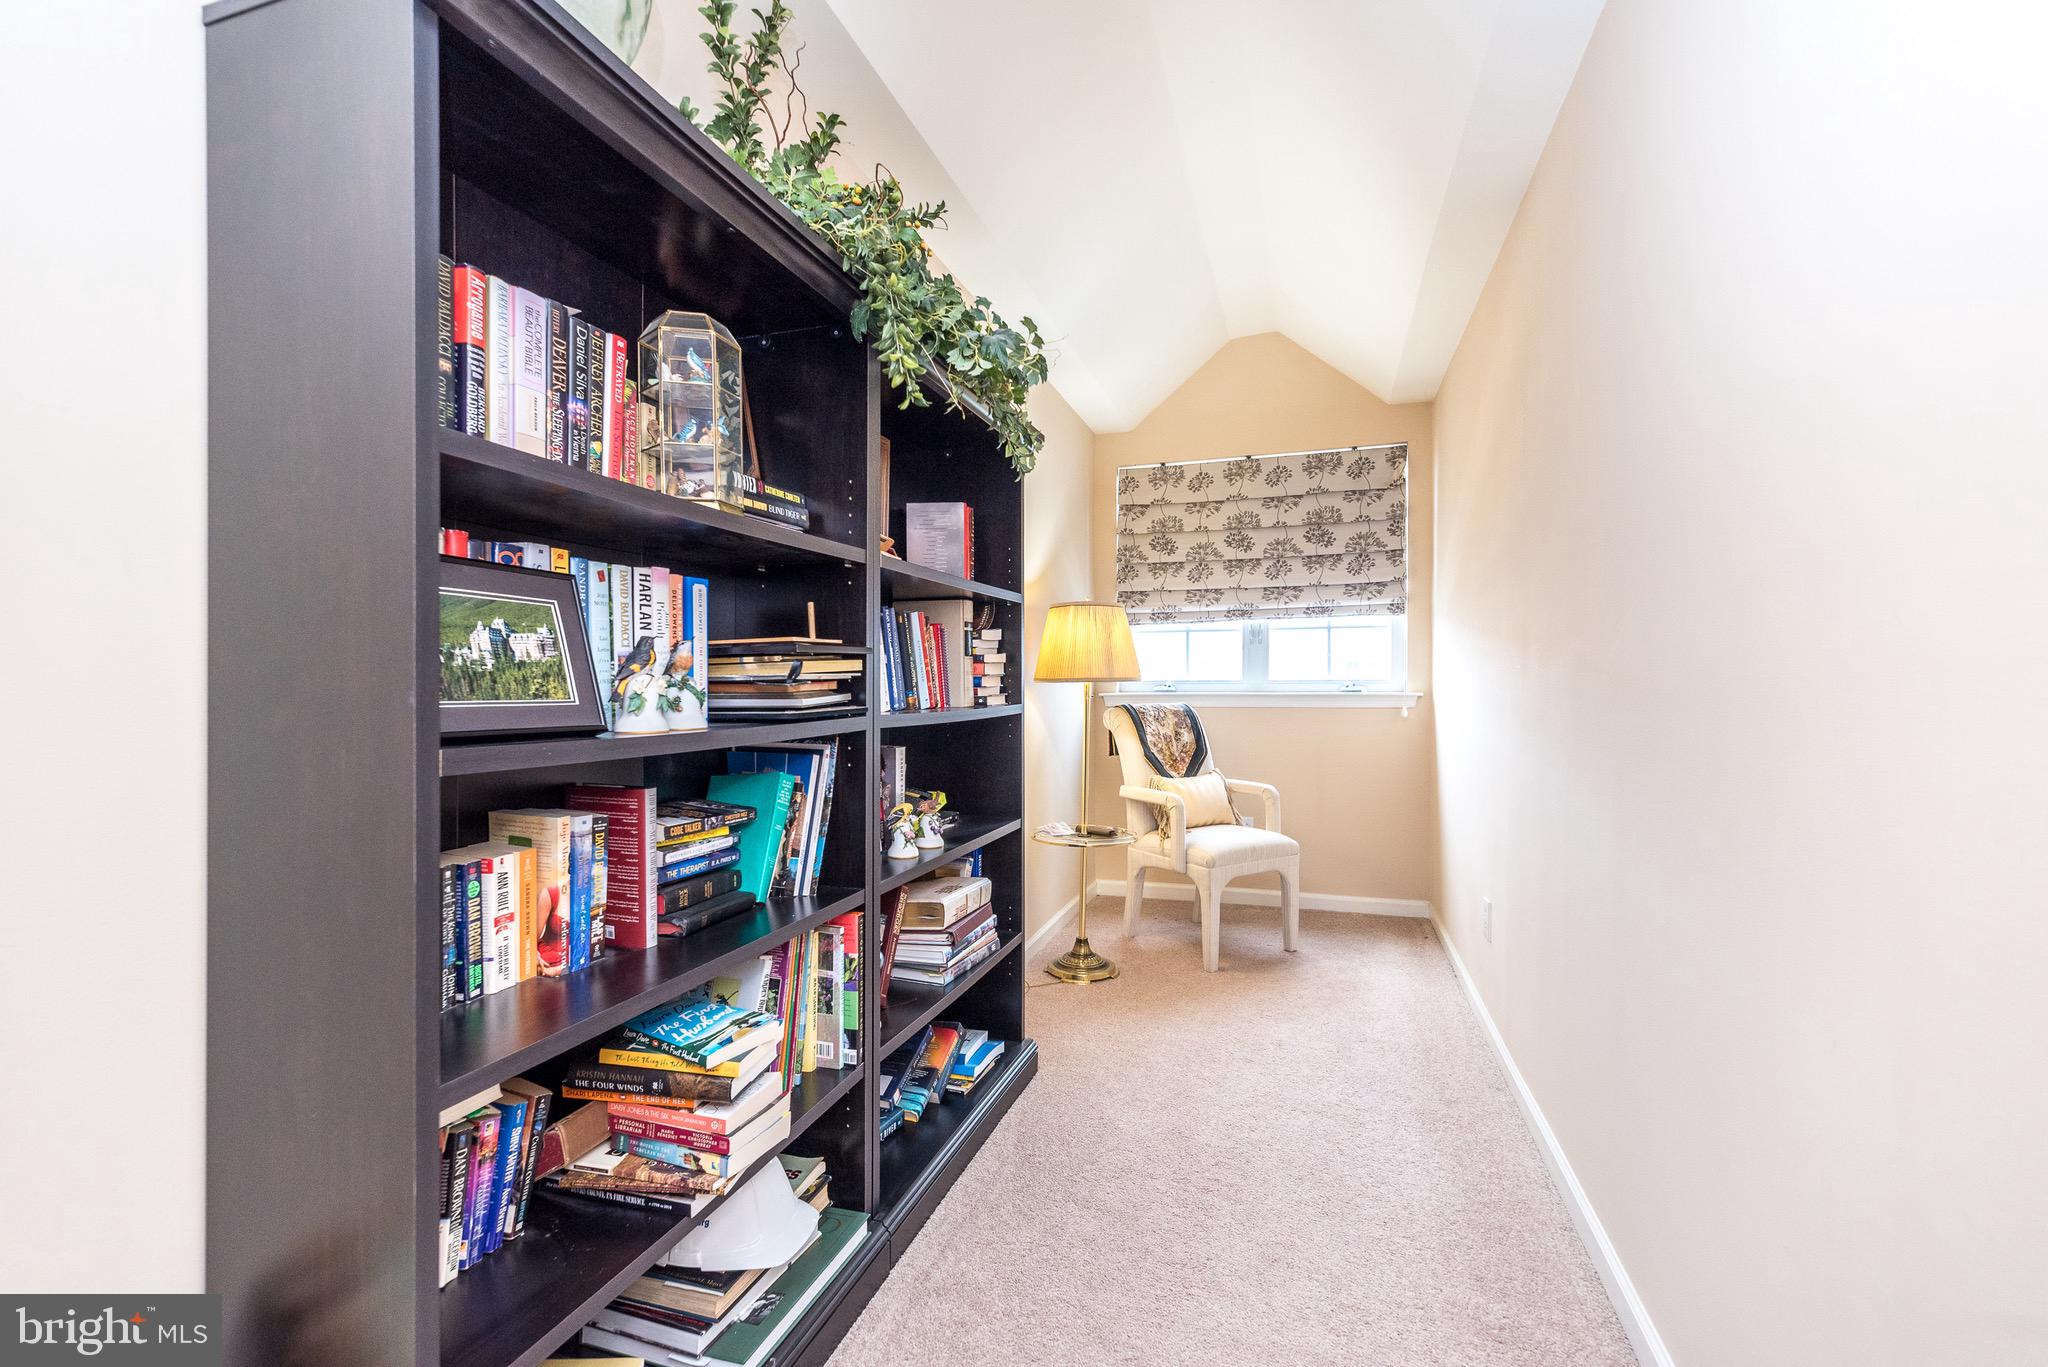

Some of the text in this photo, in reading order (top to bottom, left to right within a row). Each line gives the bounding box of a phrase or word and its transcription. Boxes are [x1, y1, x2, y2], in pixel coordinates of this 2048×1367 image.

[439, 260, 451, 358] DAVID BALDACCI
[467, 276, 485, 340] Arrogance
[552, 308, 561, 335] JEFFERY
[525, 305, 534, 375] BEAUTY BIBLE
[534, 323, 543, 379] COMPLETE
[552, 336, 567, 393] DEAVER
[576, 325, 588, 401] Daniel Silva
[590, 334, 604, 437] JEFFREY ARCHER
[614, 351, 626, 404] BETRAYED
[467, 381, 479, 435] GOLDBERG
[573, 435, 581, 461] Vienna
[768, 505, 800, 520] BLIND TIGER
[579, 563, 587, 607] SANDRA
[619, 569, 630, 649] DAVID BALDACCI
[639, 574, 652, 631] HARLAN
[559, 820, 569, 843] Jojo
[669, 825, 684, 837] CODE
[594, 832, 605, 860] DAVID
[666, 869, 679, 879] THE
[679, 861, 709, 877] THERAPIST
[497, 871, 510, 913] ANN RULE
[468, 897, 481, 962] DAN BROWN
[580, 914, 588, 931] salt
[590, 919, 598, 944] MILE
[559, 951, 568, 970] you
[448, 974, 457, 997] JOHN
[651, 1003, 720, 1036] The First
[671, 1006, 738, 1043] Husband
[626, 1054, 640, 1064] Last
[641, 1055, 660, 1067] Thing
[574, 1079, 644, 1093] THE FOUR WINDS
[576, 1068, 645, 1082] KRISTIN HANNAH
[565, 1089, 585, 1097] SHARI
[610, 1102, 626, 1113] DAISY
[626, 1105, 645, 1115] JONES
[649, 1110, 660, 1118] THE
[660, 1112, 670, 1120] SIX
[618, 1118, 646, 1129] PERSONAL
[614, 1123, 643, 1134] LIBRARIAN
[657, 1132, 678, 1141] BENEDICT
[687, 1136, 718, 1146] CHRISTOPHER
[692, 1132, 713, 1141] VICTORIA
[455, 1147, 468, 1177] DAN
[451, 1177, 465, 1218] BROWN
